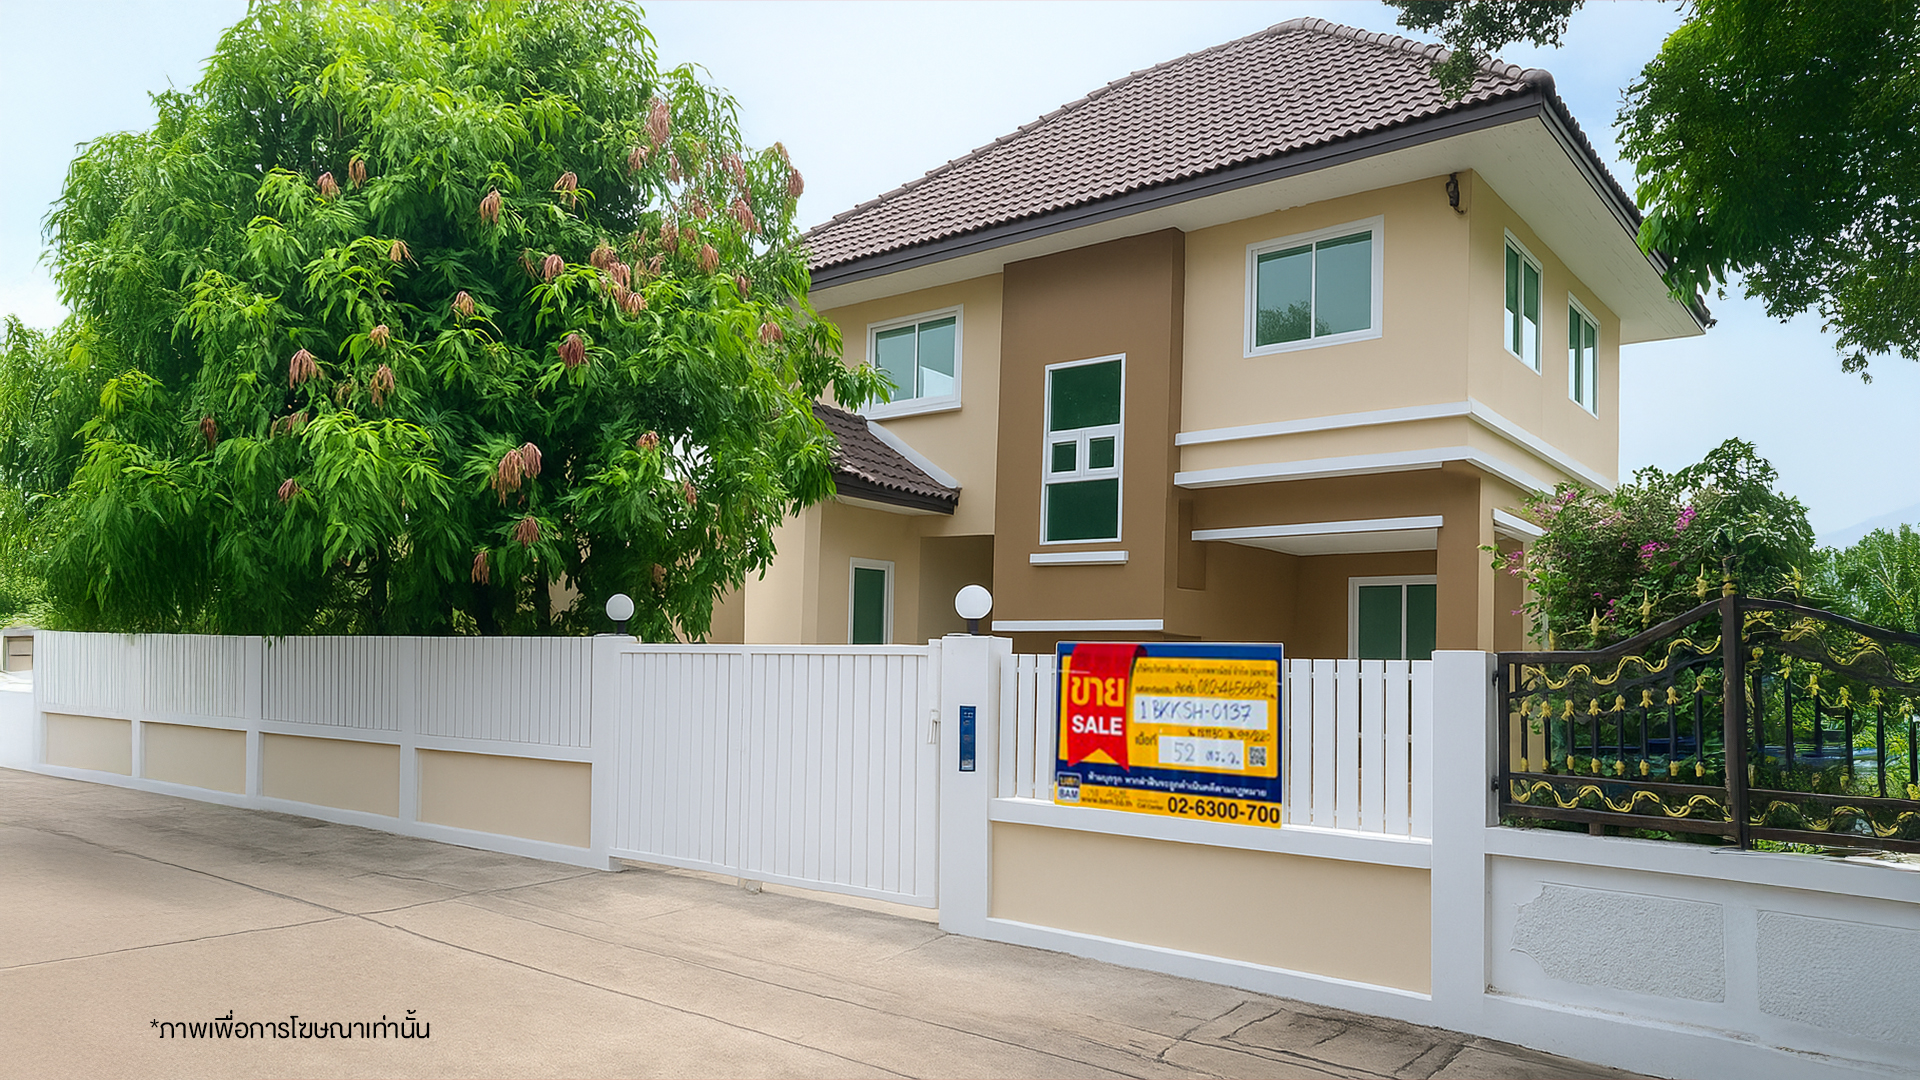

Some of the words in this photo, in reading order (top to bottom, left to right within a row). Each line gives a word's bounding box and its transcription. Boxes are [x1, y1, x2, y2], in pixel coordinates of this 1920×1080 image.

[1071, 676, 1125, 707] ขาย
[1072, 714, 1123, 736] SALE
[1174, 741, 1195, 762] 52
[1059, 788, 1078, 799] BAM
[1168, 797, 1280, 823] 02-6300-700
